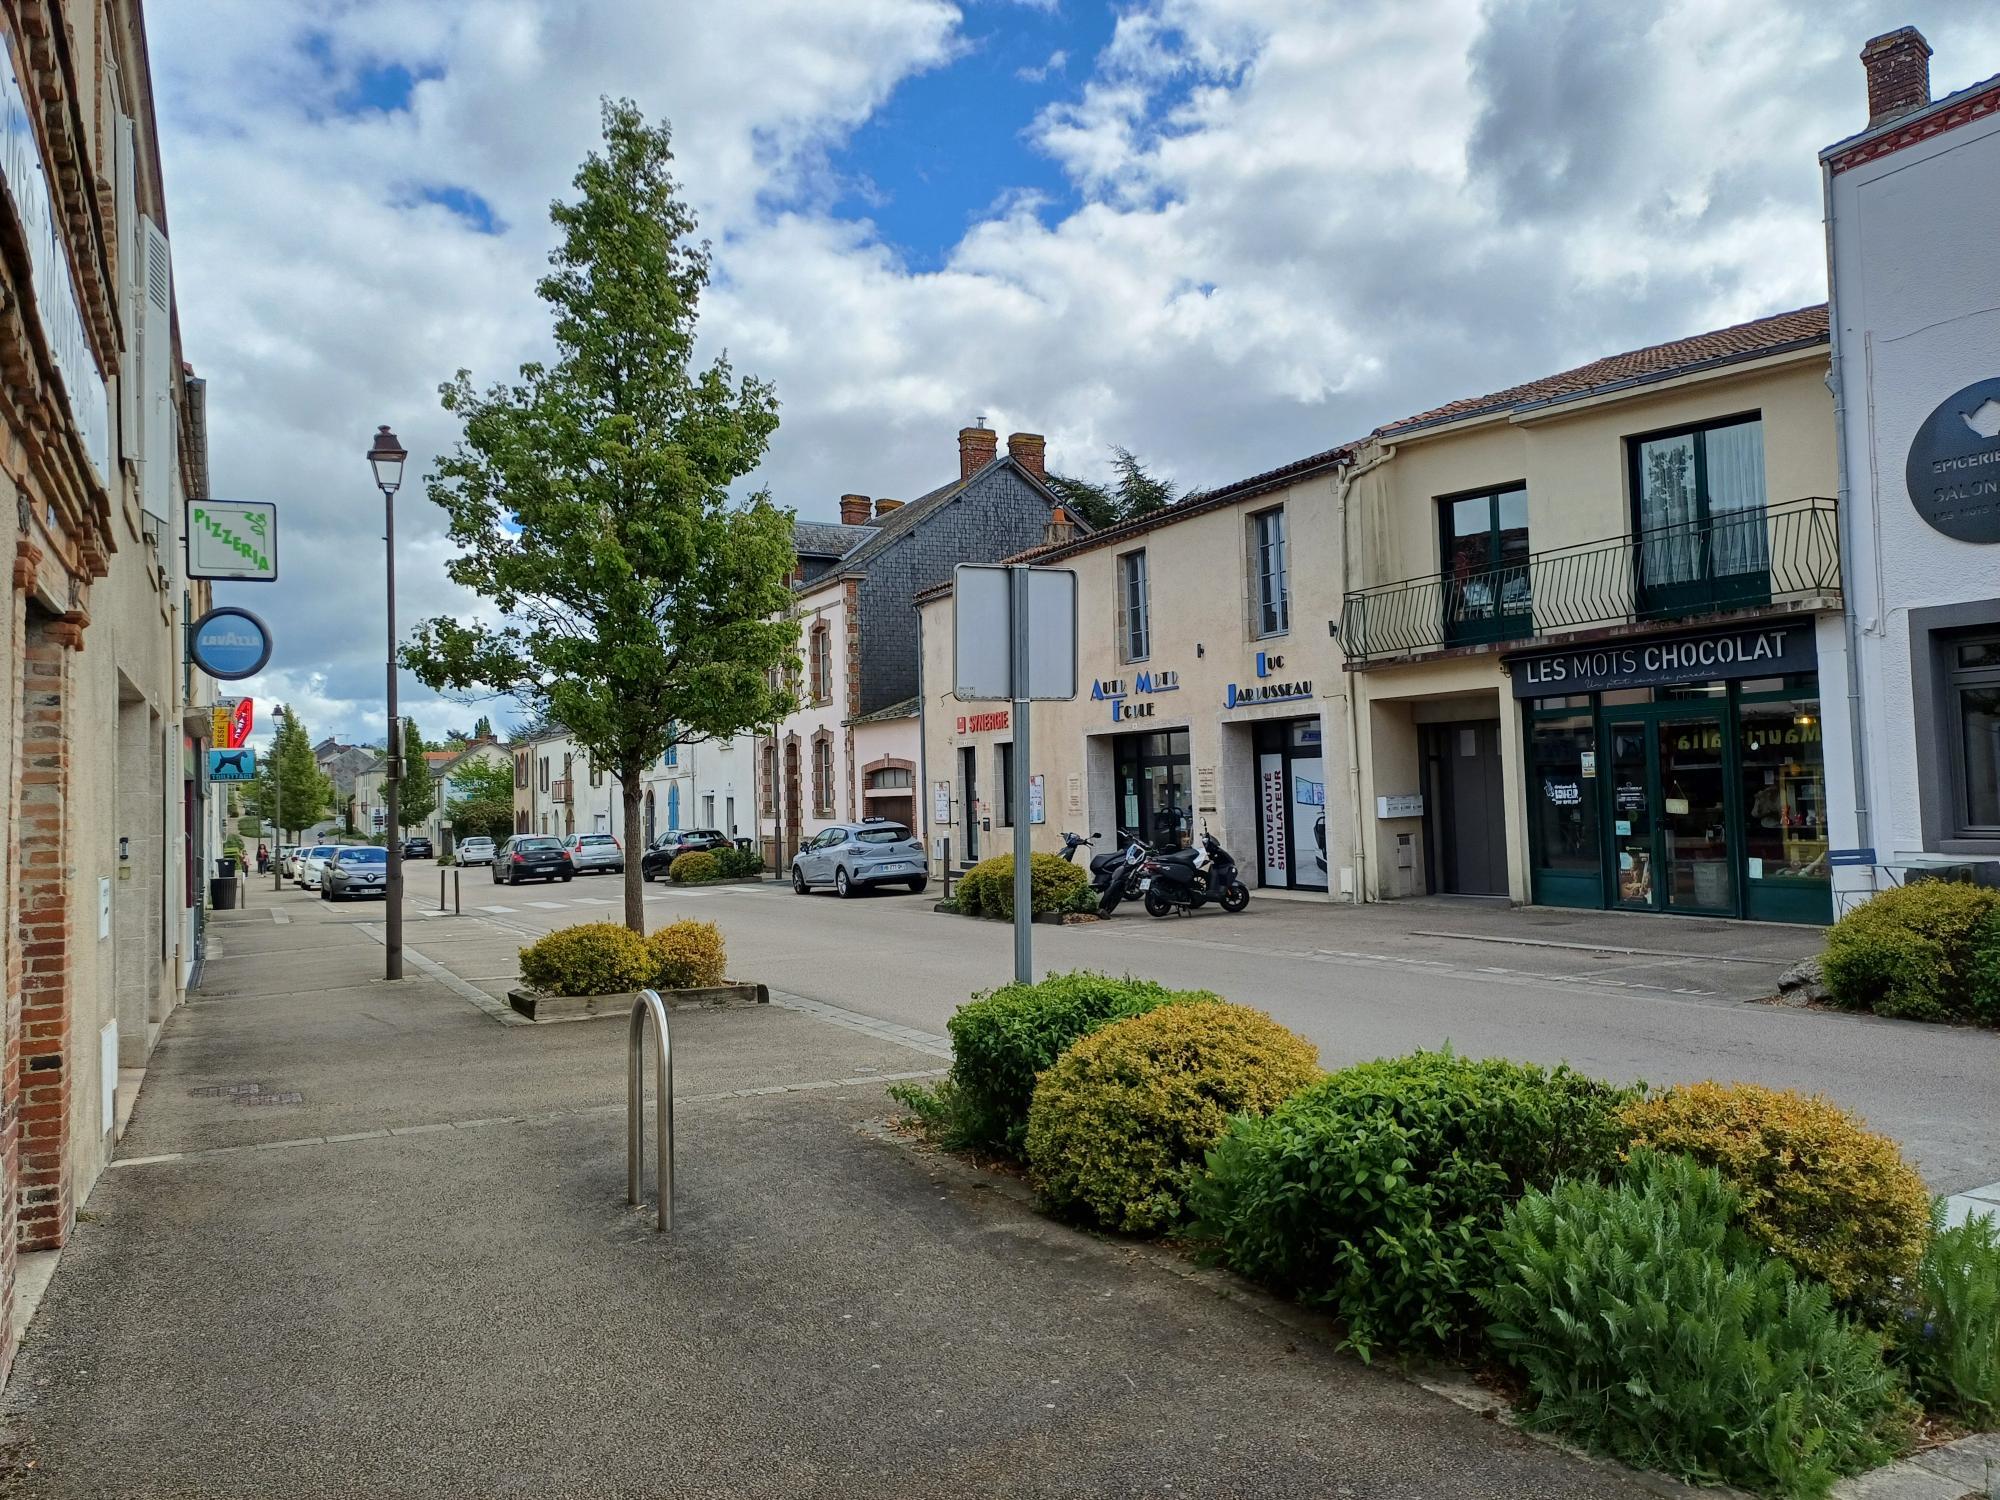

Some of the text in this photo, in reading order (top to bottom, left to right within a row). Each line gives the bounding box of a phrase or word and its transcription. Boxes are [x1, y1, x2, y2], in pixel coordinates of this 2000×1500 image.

[1934, 480, 1998, 503] SALON
[194, 508, 270, 570] PIZZERIA
[1256, 652, 1285, 678] LUC
[1527, 632, 1787, 683] LES MOTS CHOCOLAT
[1223, 680, 1313, 709] JAROUSSEAU
[233, 711, 248, 739] TABAC
[969, 711, 1009, 733] SYNERGIE
[1263, 772, 1275, 867] NOUVEAUTÉ
[1274, 770, 1285, 871] SIMULATEUR
